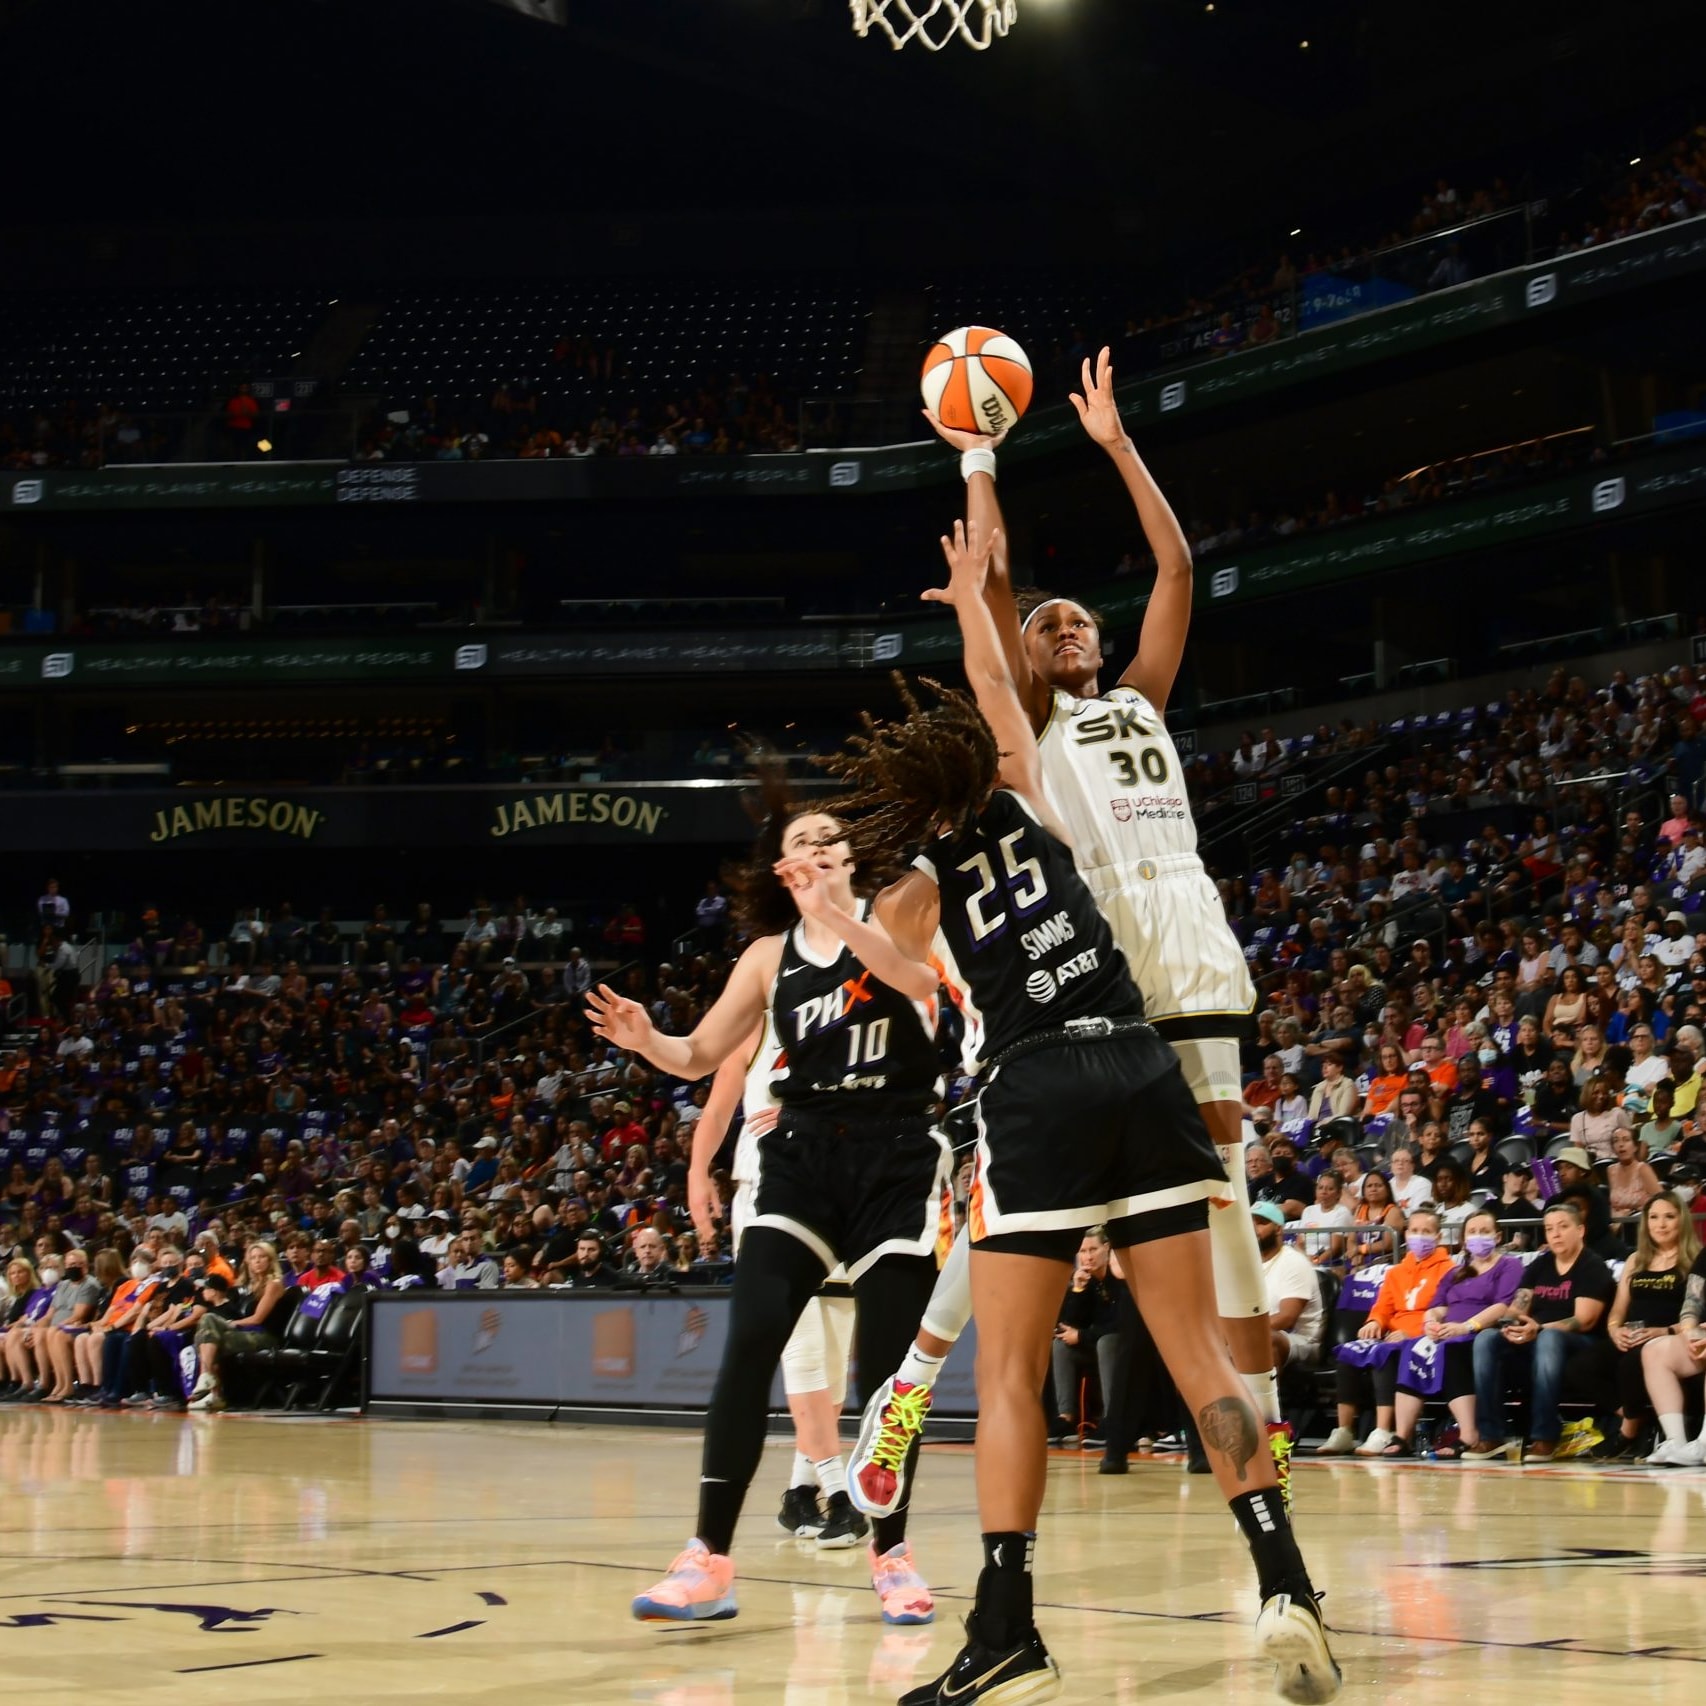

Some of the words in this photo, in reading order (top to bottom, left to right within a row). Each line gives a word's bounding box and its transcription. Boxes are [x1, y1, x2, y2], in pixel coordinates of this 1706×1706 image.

[1432, 296, 1504, 325] PEOPLE
[337, 467, 418, 484] DEFENSE
[337, 485, 418, 502] DEFENSE
[1637, 465, 1706, 491] HEALT
[1492, 497, 1570, 527] PEOPLE
[354, 651, 434, 665] PEOPLE
[912, 634, 962, 649] HEAL
[1073, 708, 1153, 746] SK
[1109, 747, 1169, 787] 30
[149, 797, 321, 842] JAMESON
[488, 792, 664, 837] JAMESON
[1132, 795, 1182, 808] UChicago
[953, 827, 1050, 947] 25
[1020, 910, 1076, 961] SIMMS
[1055, 948, 1100, 986] AT&T
[791, 968, 875, 1044] PHX
[846, 1017, 891, 1068] 10
